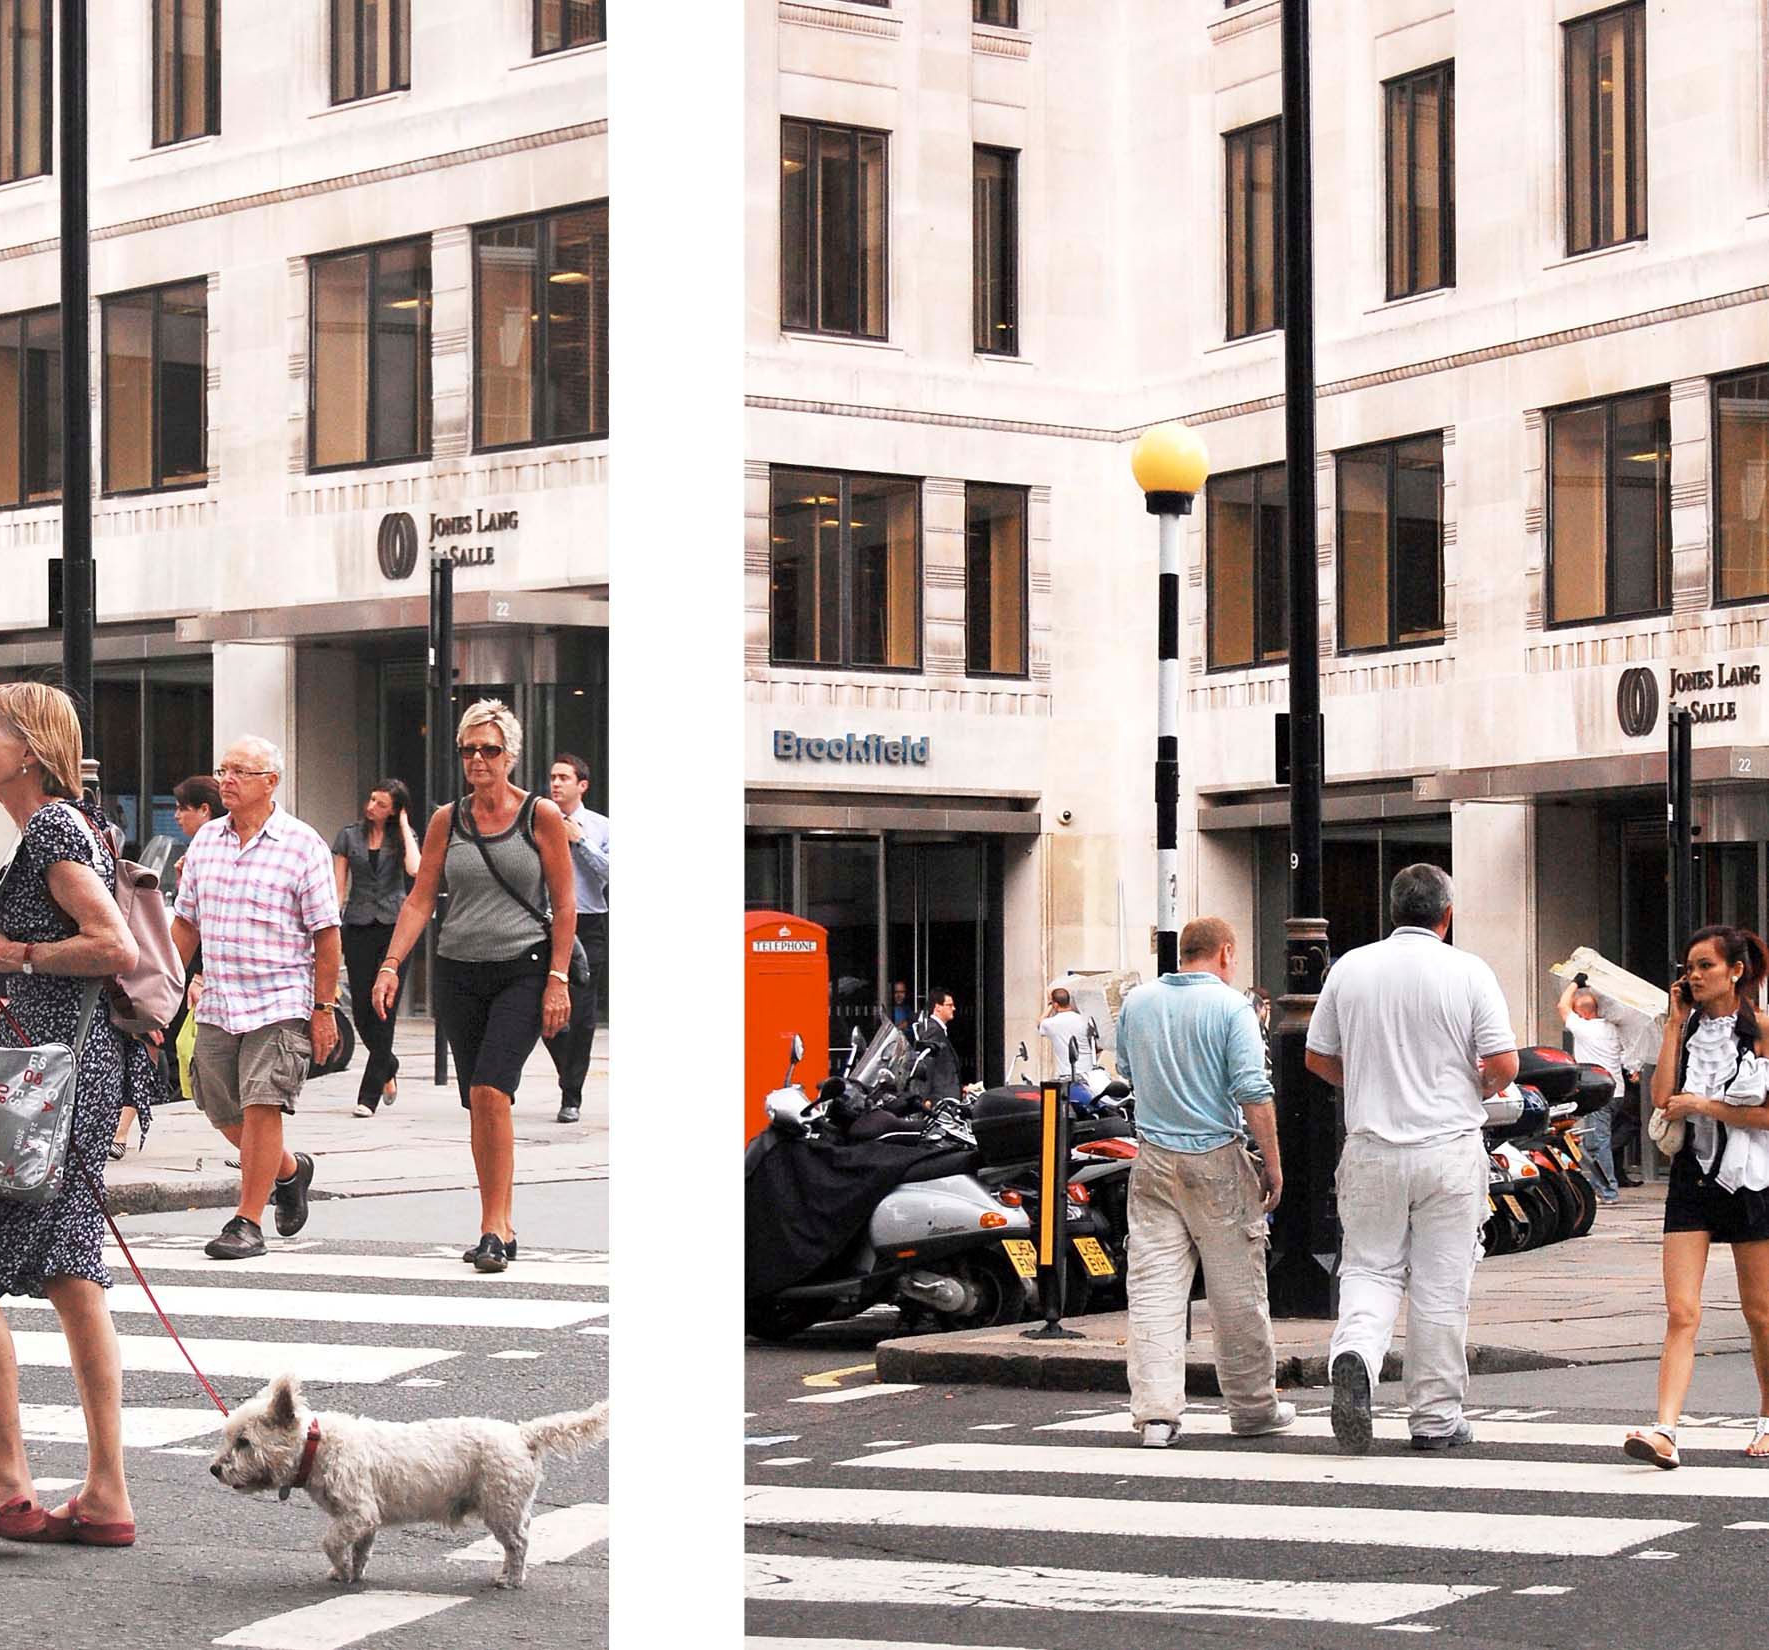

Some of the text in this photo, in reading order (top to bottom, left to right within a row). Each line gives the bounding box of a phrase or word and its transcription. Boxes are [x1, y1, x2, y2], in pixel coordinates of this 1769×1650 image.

[428, 545, 495, 569] SALLE
[495, 601, 510, 617] 22
[1668, 701, 1737, 724] SALLE
[773, 730, 930, 765] Brookfield
[1738, 758, 1752, 772] 22
[1290, 852, 1300, 870] 9
[755, 941, 815, 951] TELEPHONE
[23, 1069, 43, 1086] 08
